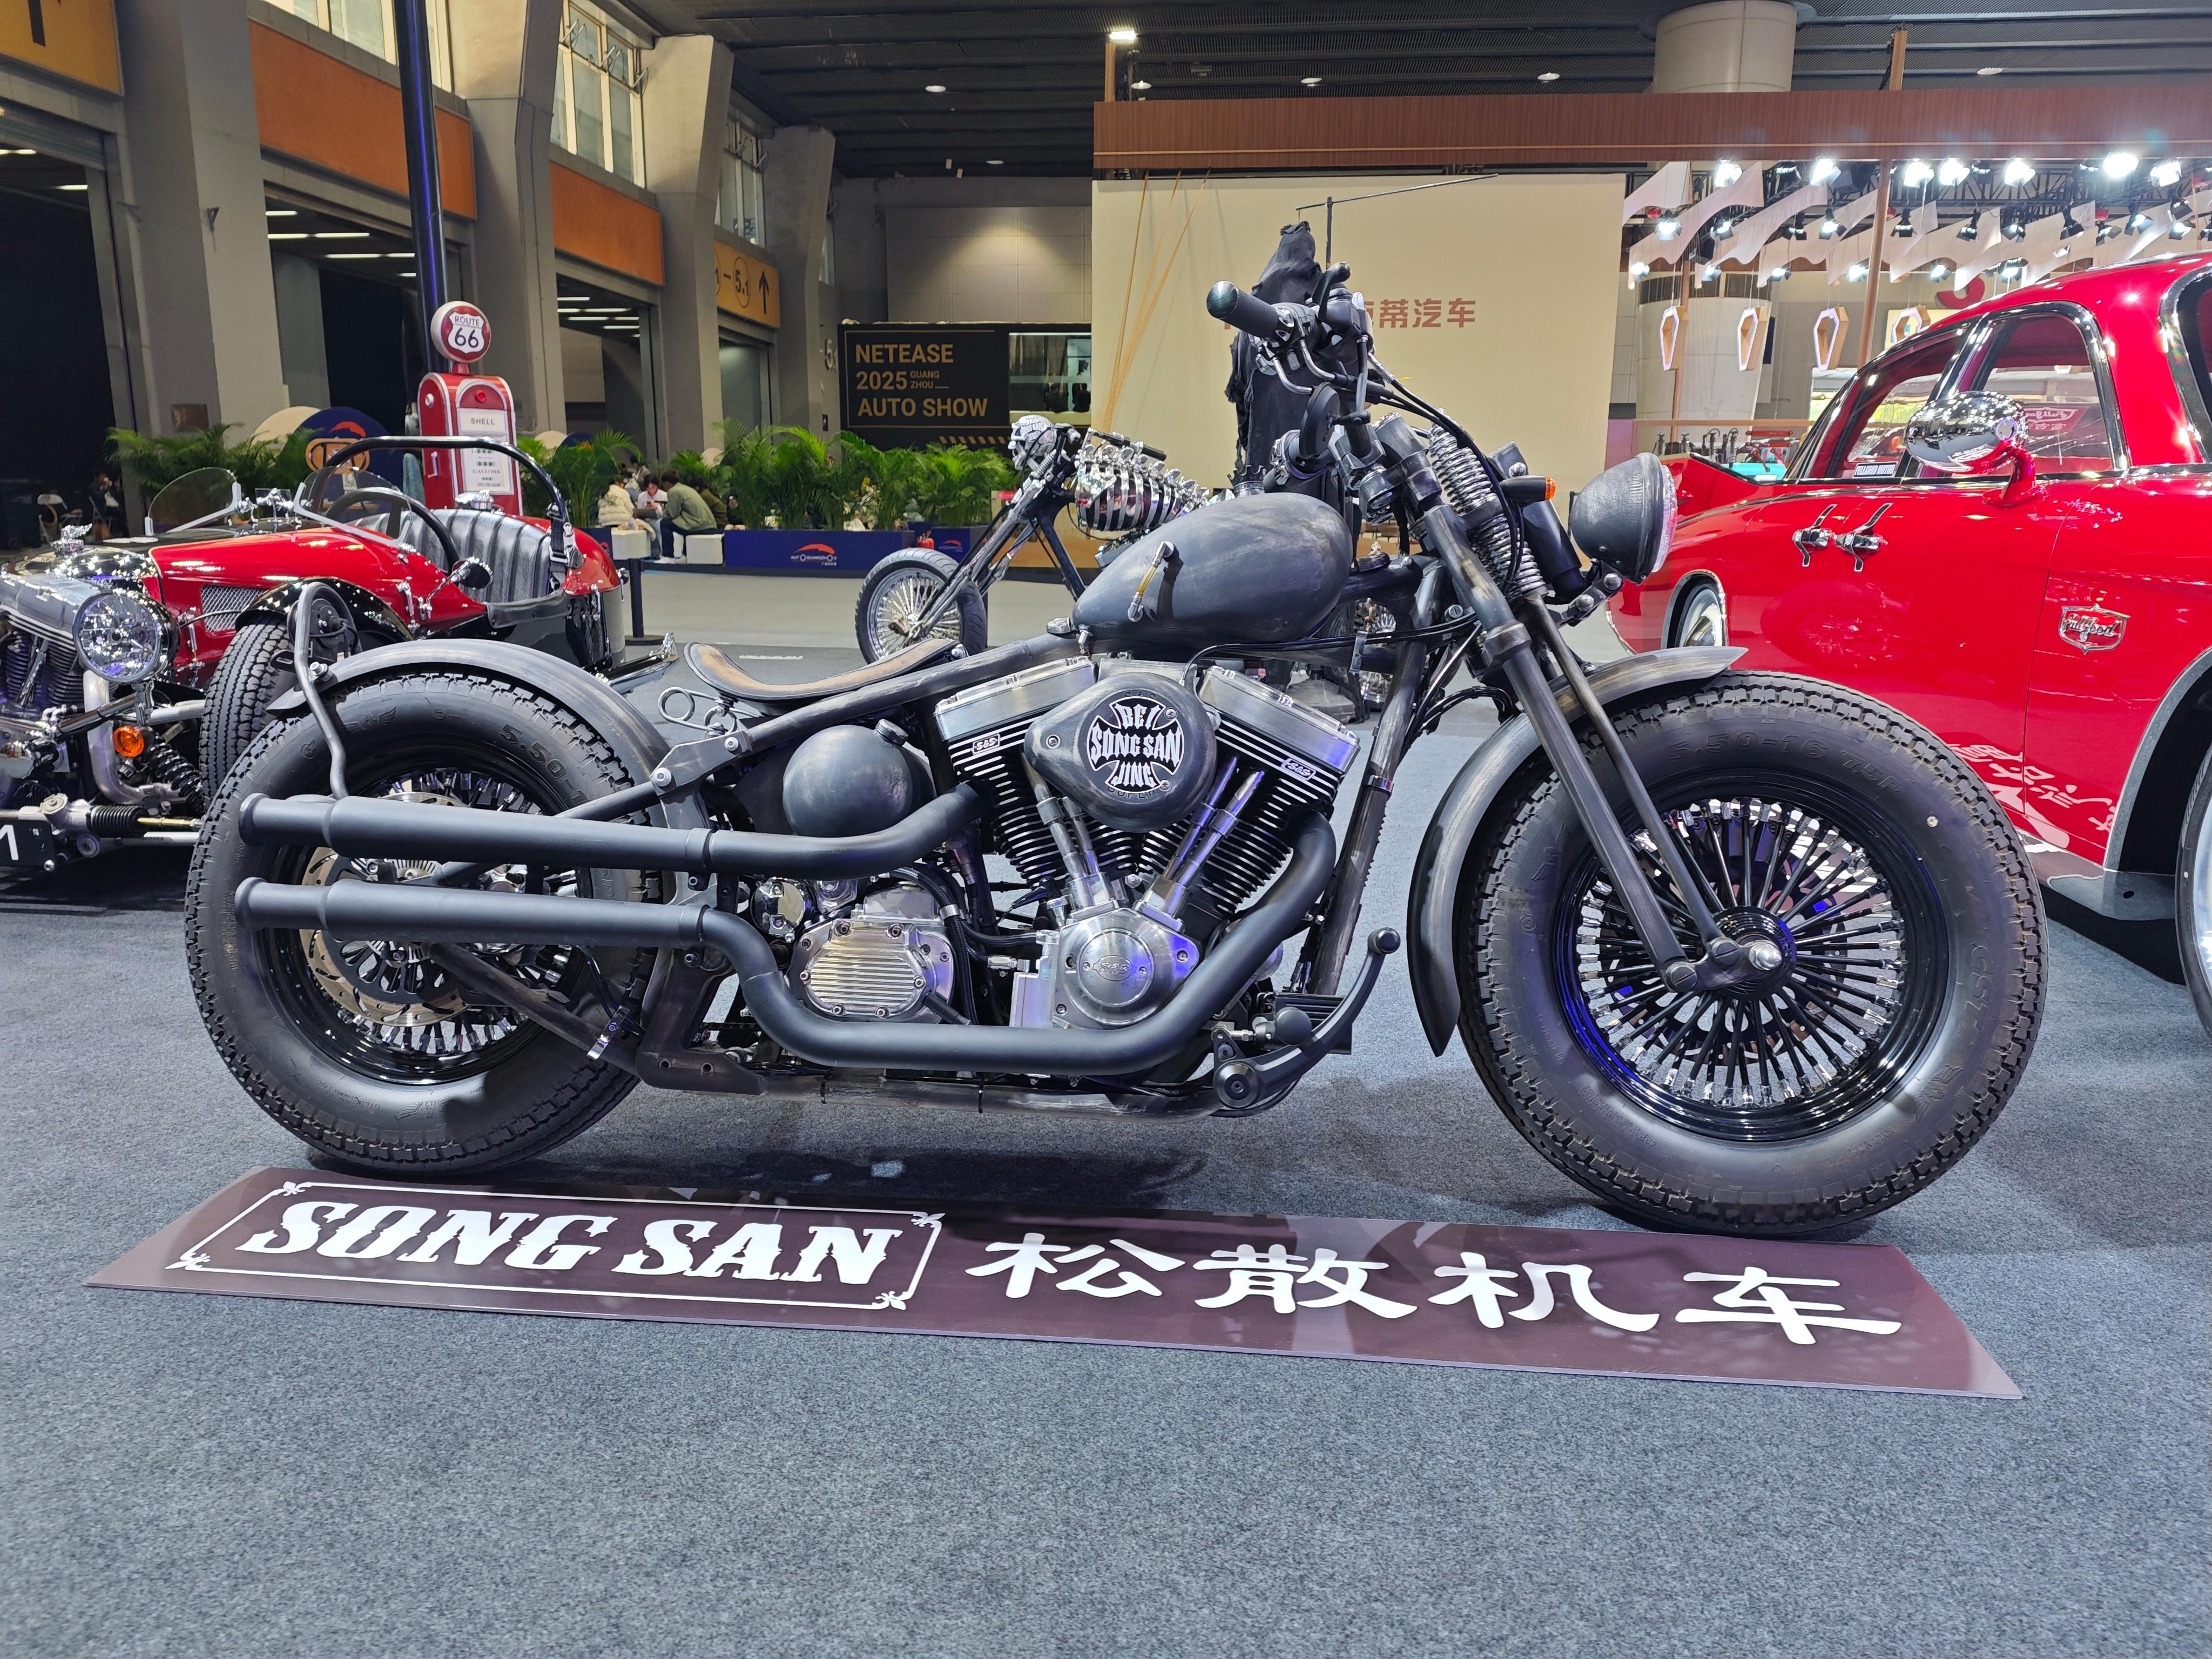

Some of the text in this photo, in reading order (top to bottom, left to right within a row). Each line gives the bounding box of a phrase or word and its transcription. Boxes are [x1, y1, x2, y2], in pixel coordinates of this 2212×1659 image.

[455, 316, 480, 327] ROUTE
[455, 327, 478, 348] 66
[855, 344, 954, 363] NETEASE
[856, 370, 940, 390] 2025 GUANG
[911, 381, 934, 389] ZHOU
[858, 398, 988, 417] AUTO SHOW
[470, 417, 495, 426] SHELL
[1114, 703, 1162, 730] BEI
[976, 737, 997, 751] S&S
[1142, 725, 1182, 768] SAN
[235, 1202, 902, 1284] SONG SAN
[965, 1233, 1901, 1344] 松散机车
